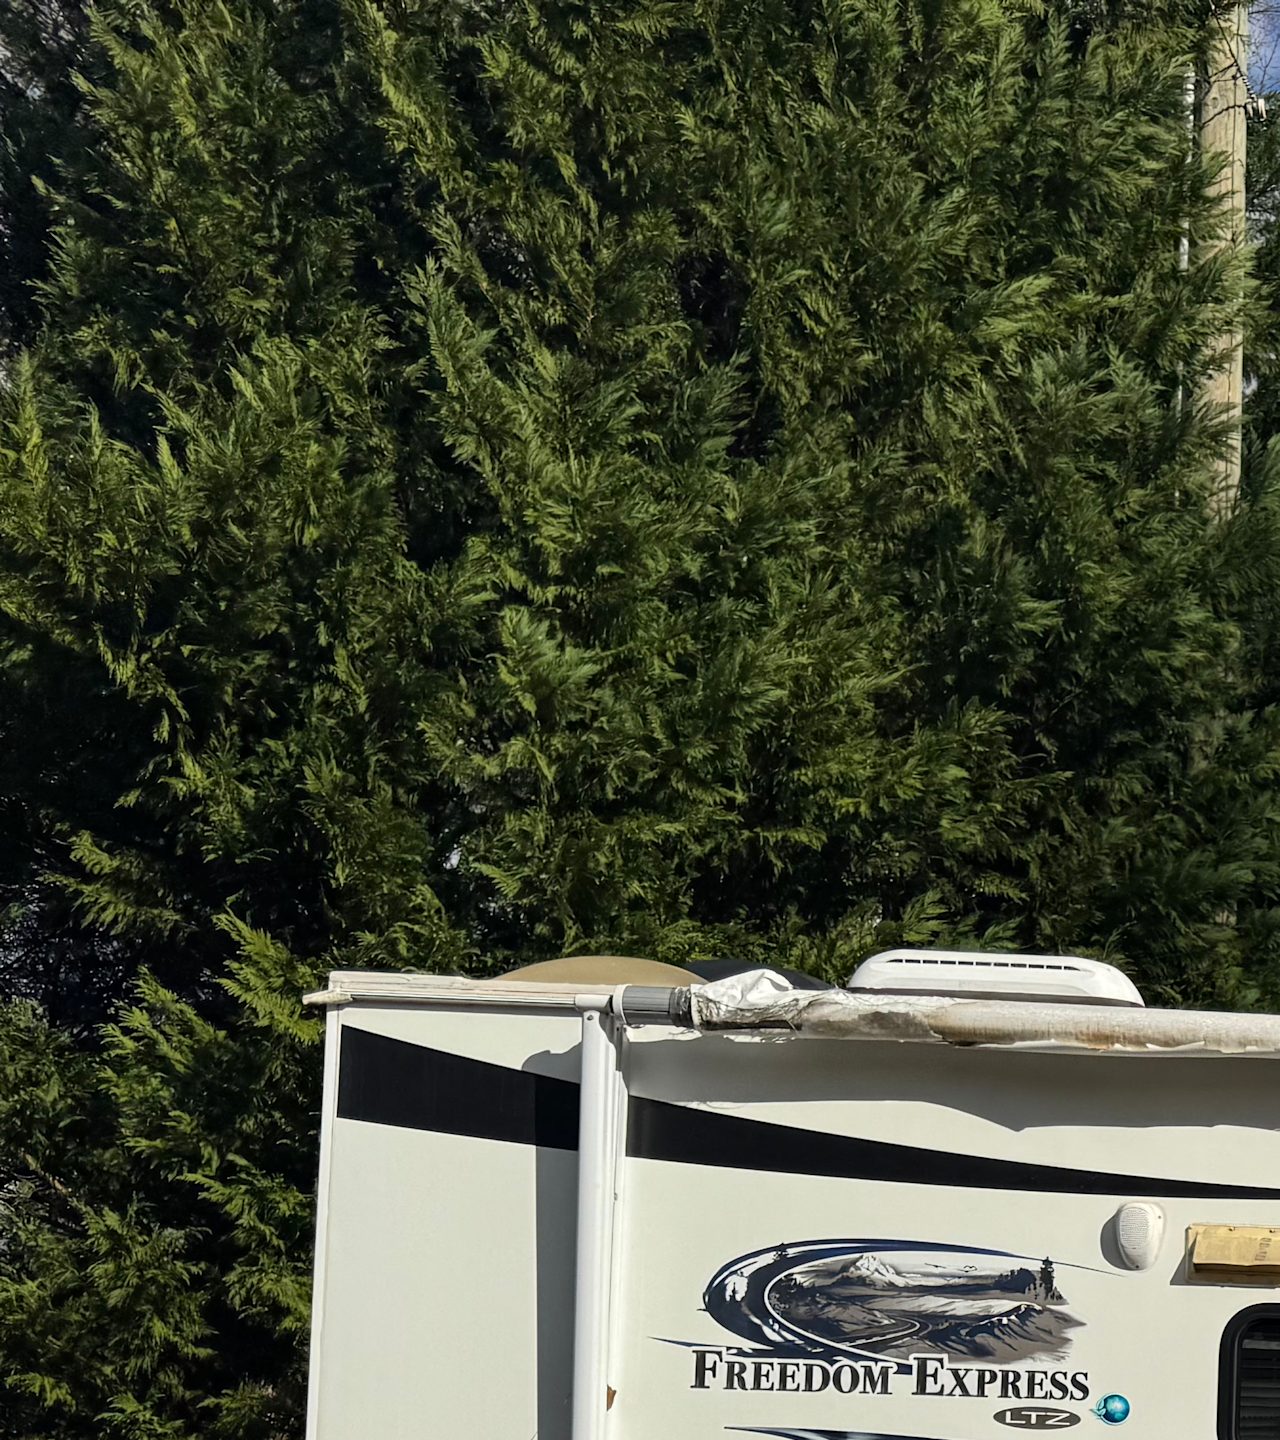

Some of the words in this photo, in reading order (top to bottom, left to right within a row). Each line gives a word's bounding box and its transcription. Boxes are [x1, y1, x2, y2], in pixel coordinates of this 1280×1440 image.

[690, 1350, 893, 1394] FREEDOM
[912, 1357, 1090, 1402] EXPRESS
[1004, 1410, 1071, 1425] LTZ
